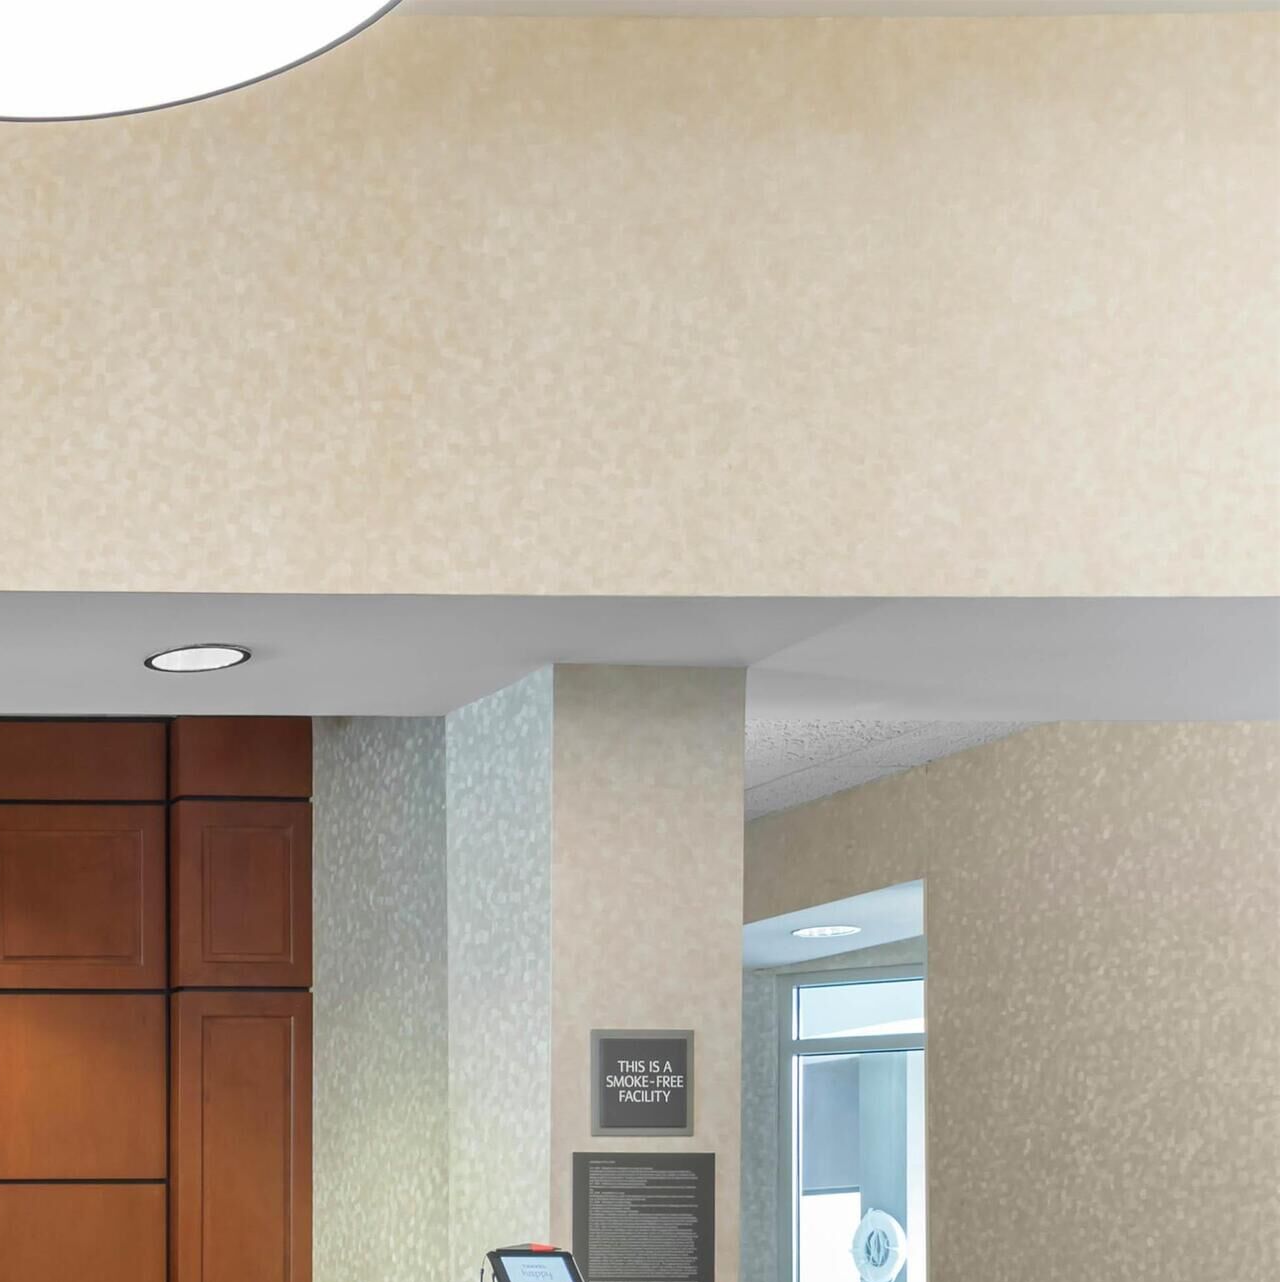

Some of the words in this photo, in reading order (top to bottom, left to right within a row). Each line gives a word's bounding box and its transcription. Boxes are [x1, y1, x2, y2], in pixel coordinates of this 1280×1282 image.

[617, 1060, 645, 1073] THIS
[649, 1060, 660, 1073] IS
[662, 1060, 673, 1073] A
[605, 1074, 684, 1088] SMOKE-FREE
[618, 1089, 671, 1103] FACILITY
[520, 1268, 554, 1281] happy
